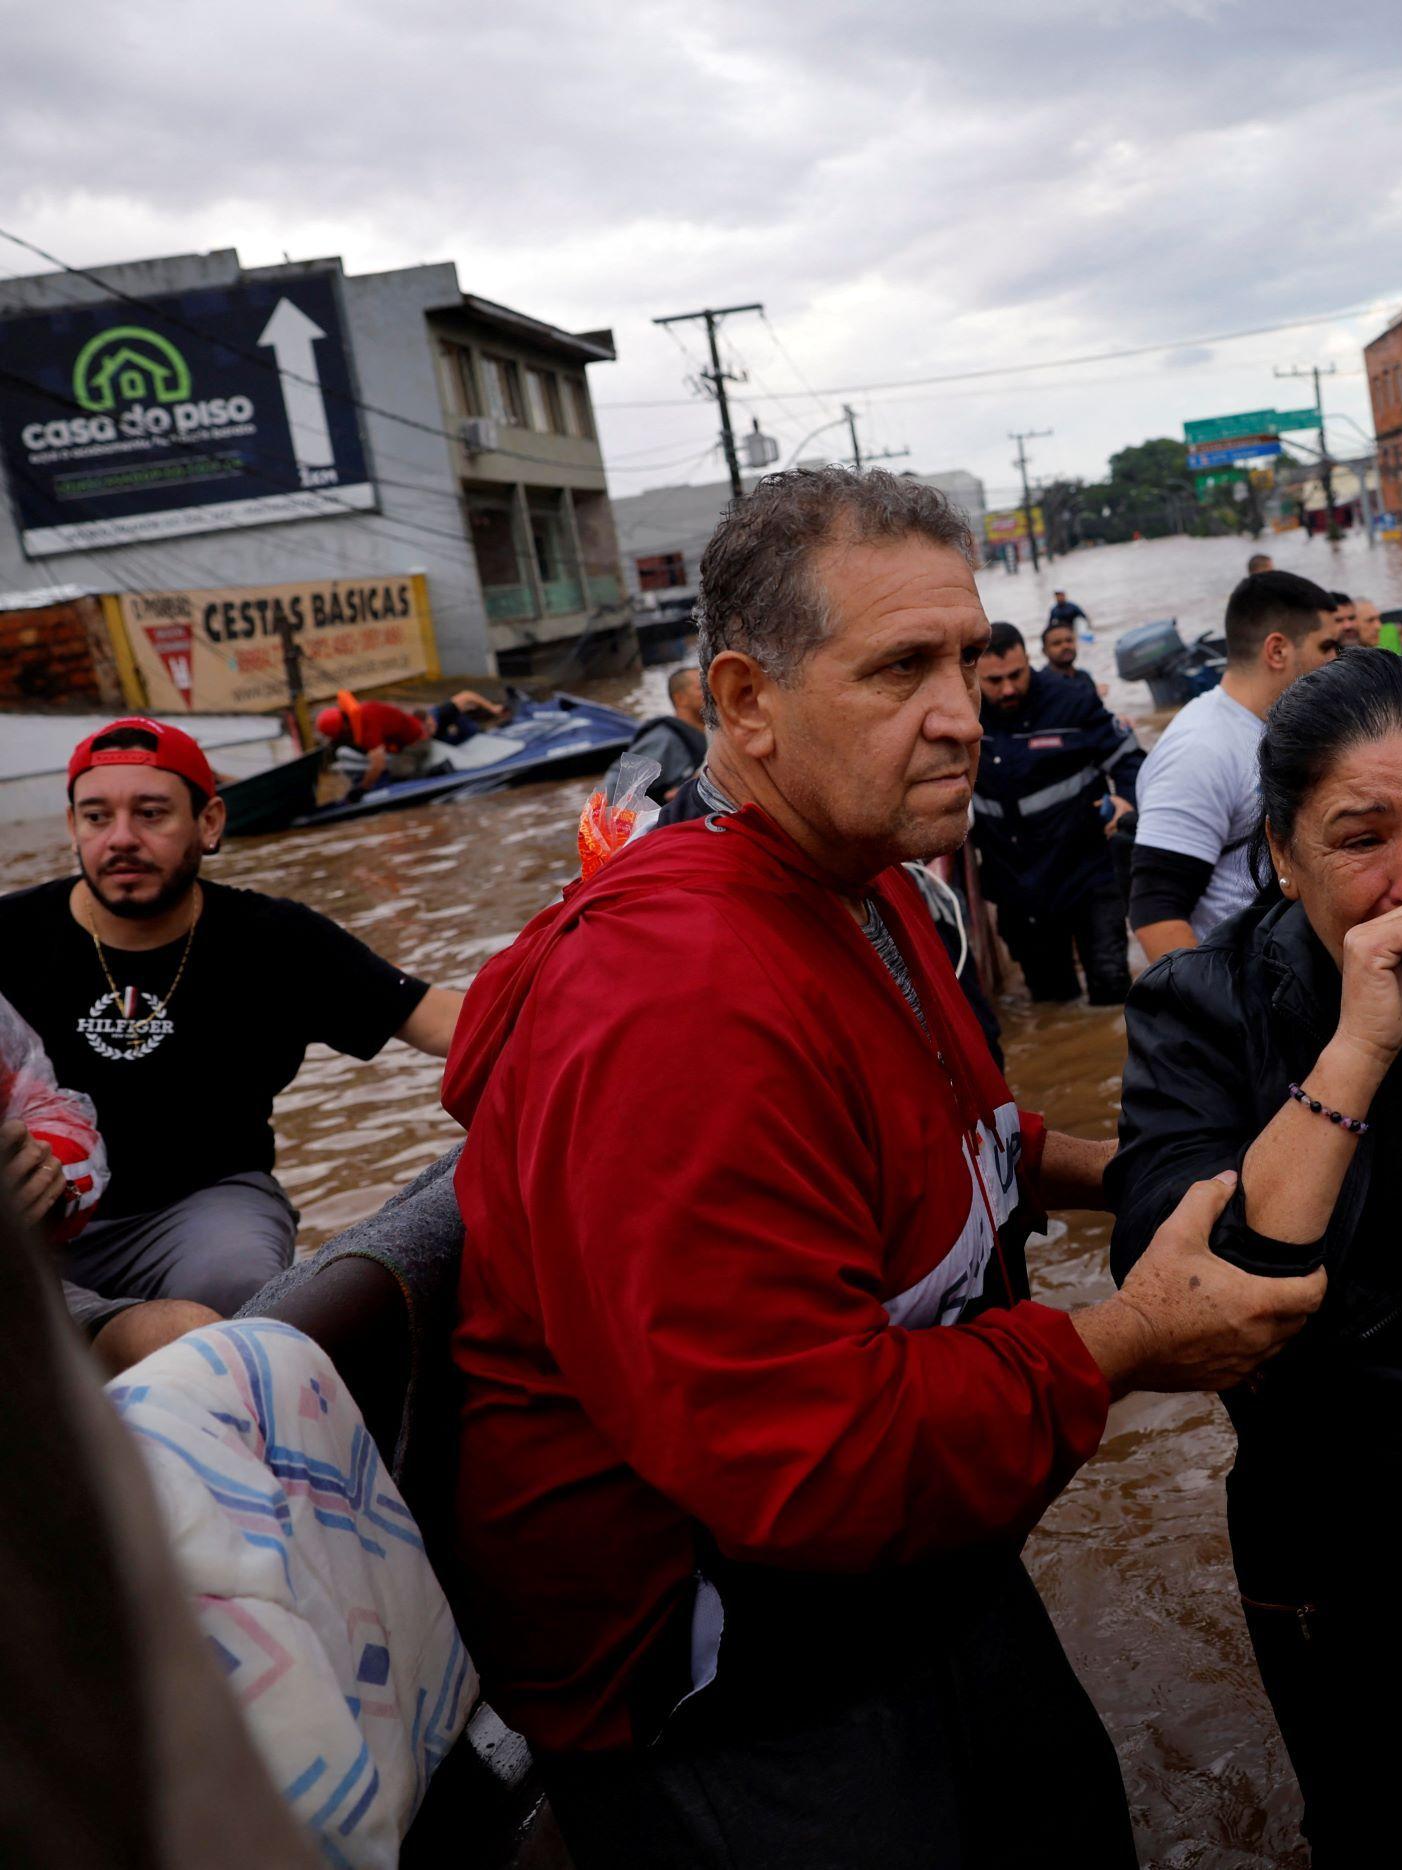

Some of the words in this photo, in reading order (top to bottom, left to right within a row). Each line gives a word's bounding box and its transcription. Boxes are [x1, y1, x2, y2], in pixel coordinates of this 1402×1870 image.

[22, 416, 117, 450] casa
[119, 402, 172, 437] do
[173, 395, 255, 435] piso
[204, 598, 304, 642] CESTAS
[311, 581, 410, 628] BÁSICAS
[76, 1018, 175, 1034] HILFIGER
